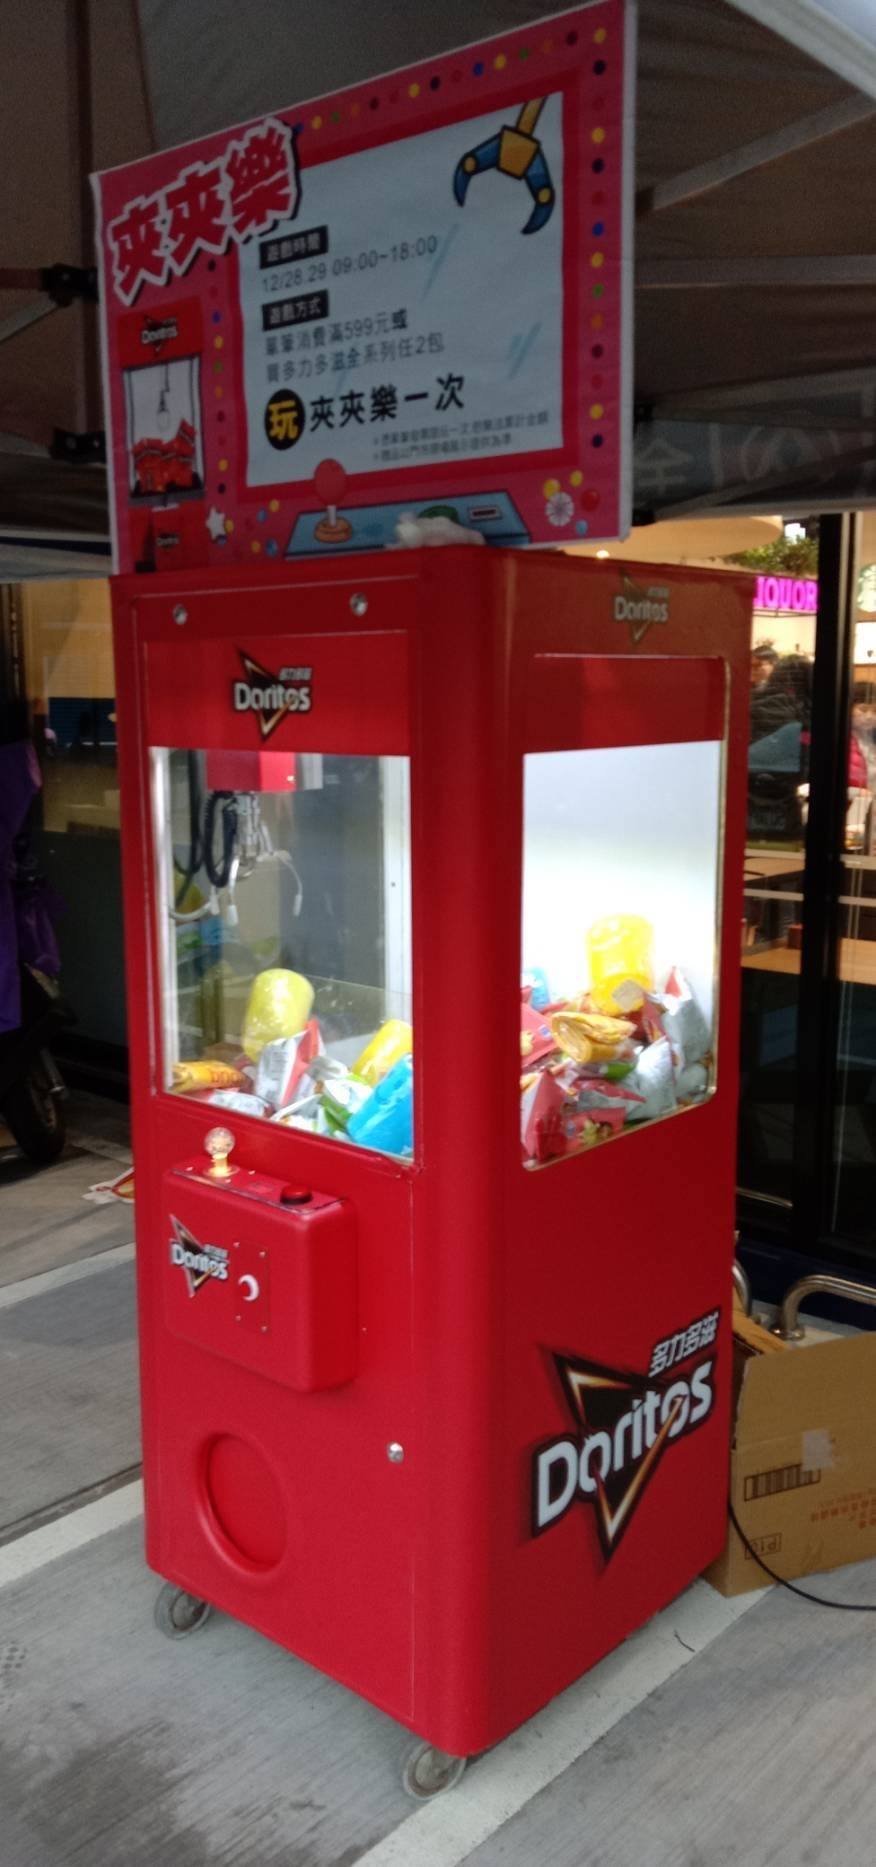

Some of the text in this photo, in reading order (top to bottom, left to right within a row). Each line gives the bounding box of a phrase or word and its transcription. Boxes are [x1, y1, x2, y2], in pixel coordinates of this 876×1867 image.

[110, 122, 294, 301] 夾夾樂
[269, 372, 465, 440] 玩 夾夾樂一次
[614, 596, 669, 622] Doritos
[753, 576, 818, 611] IQUOR
[234, 682, 312, 711] Doritos
[172, 1243, 228, 1281] Doritos
[648, 1311, 720, 1378] 多力多滋
[537, 1360, 714, 1528] Doritos
